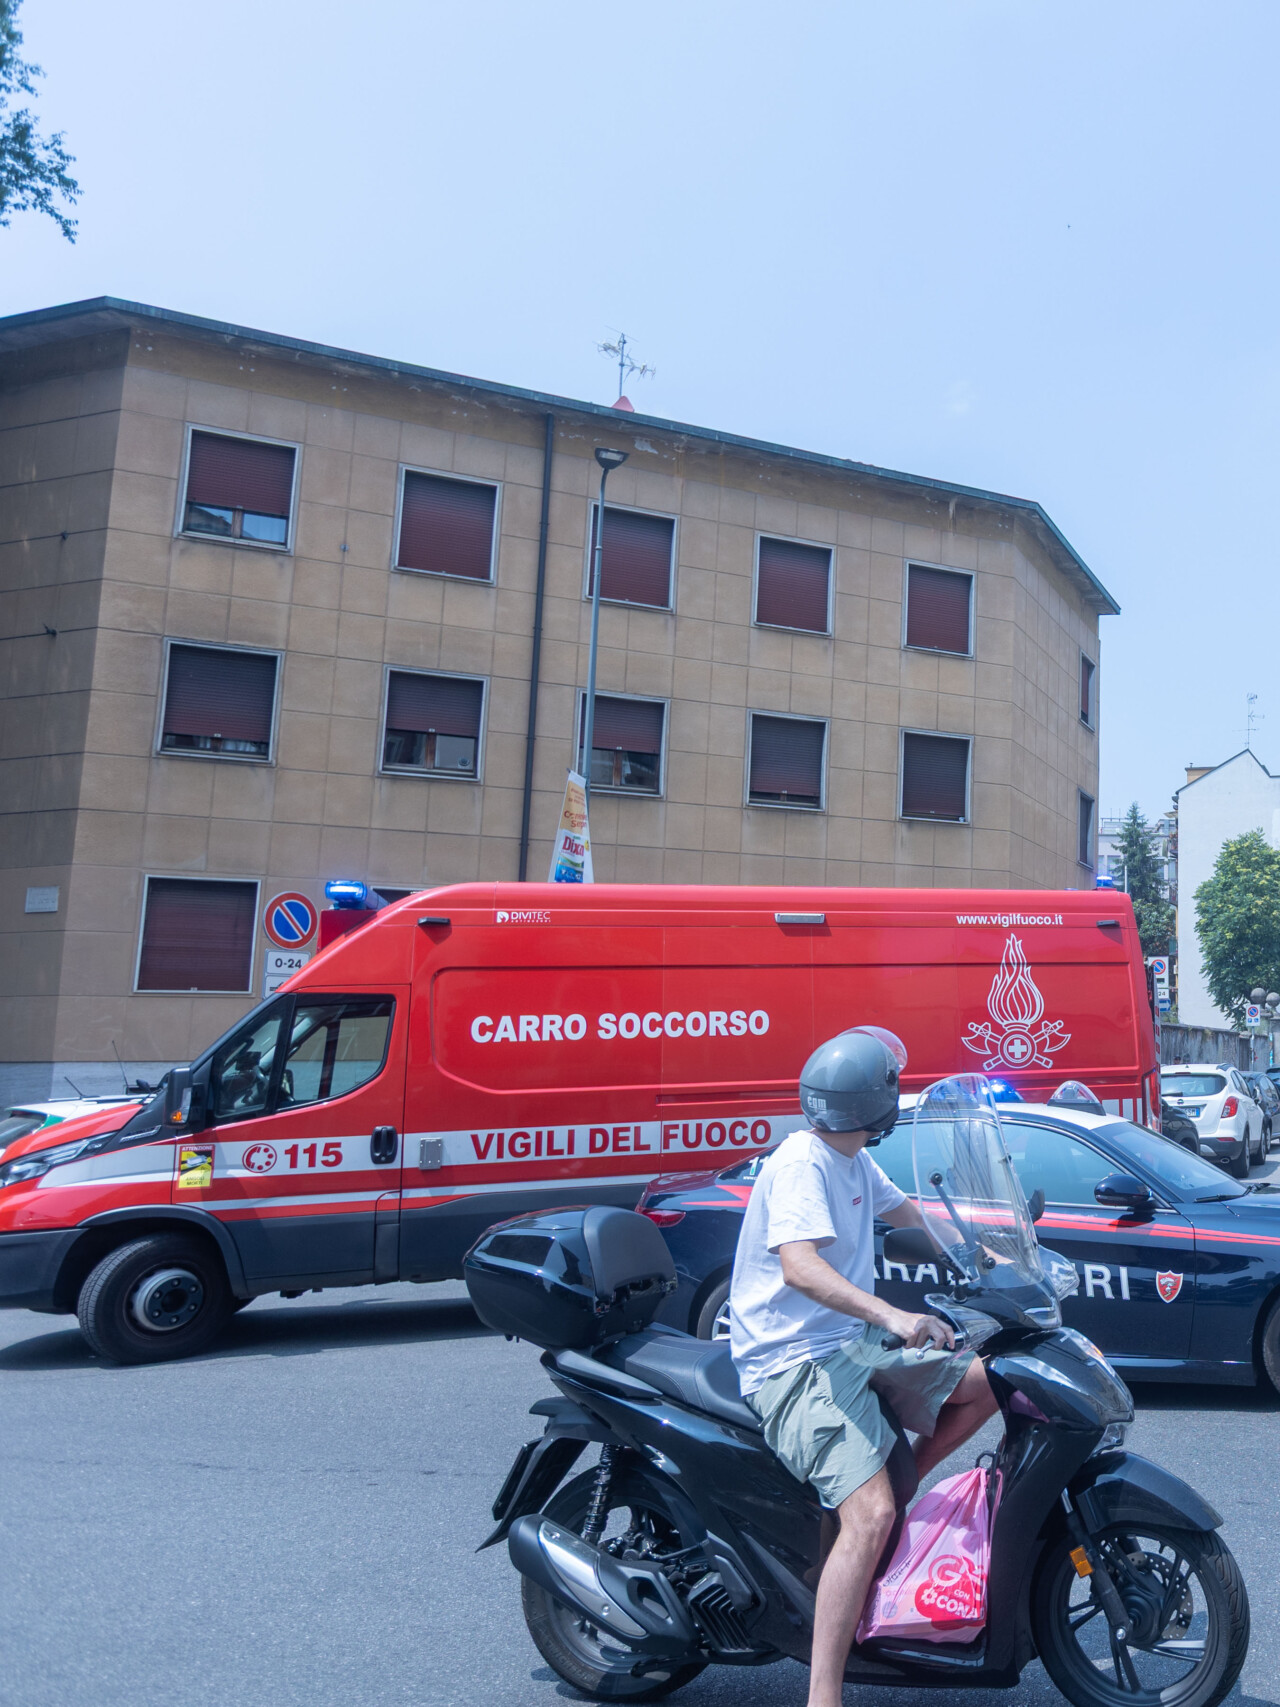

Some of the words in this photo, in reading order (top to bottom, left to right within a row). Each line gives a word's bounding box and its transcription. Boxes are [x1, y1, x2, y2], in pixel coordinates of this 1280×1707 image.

[510, 911, 551, 920] DIVITEC
[956, 913, 1063, 928] www.vigilfuoco.it
[275, 957, 302, 969] 0-24
[470, 1013, 587, 1043] CARRO
[597, 1009, 770, 1040] SOCCORSO
[470, 1128, 576, 1161] VIGILI
[588, 1125, 651, 1155] DEL
[662, 1119, 772, 1150] FUOCO
[284, 1141, 343, 1169] 115
[953, 1589, 970, 1600] CON
